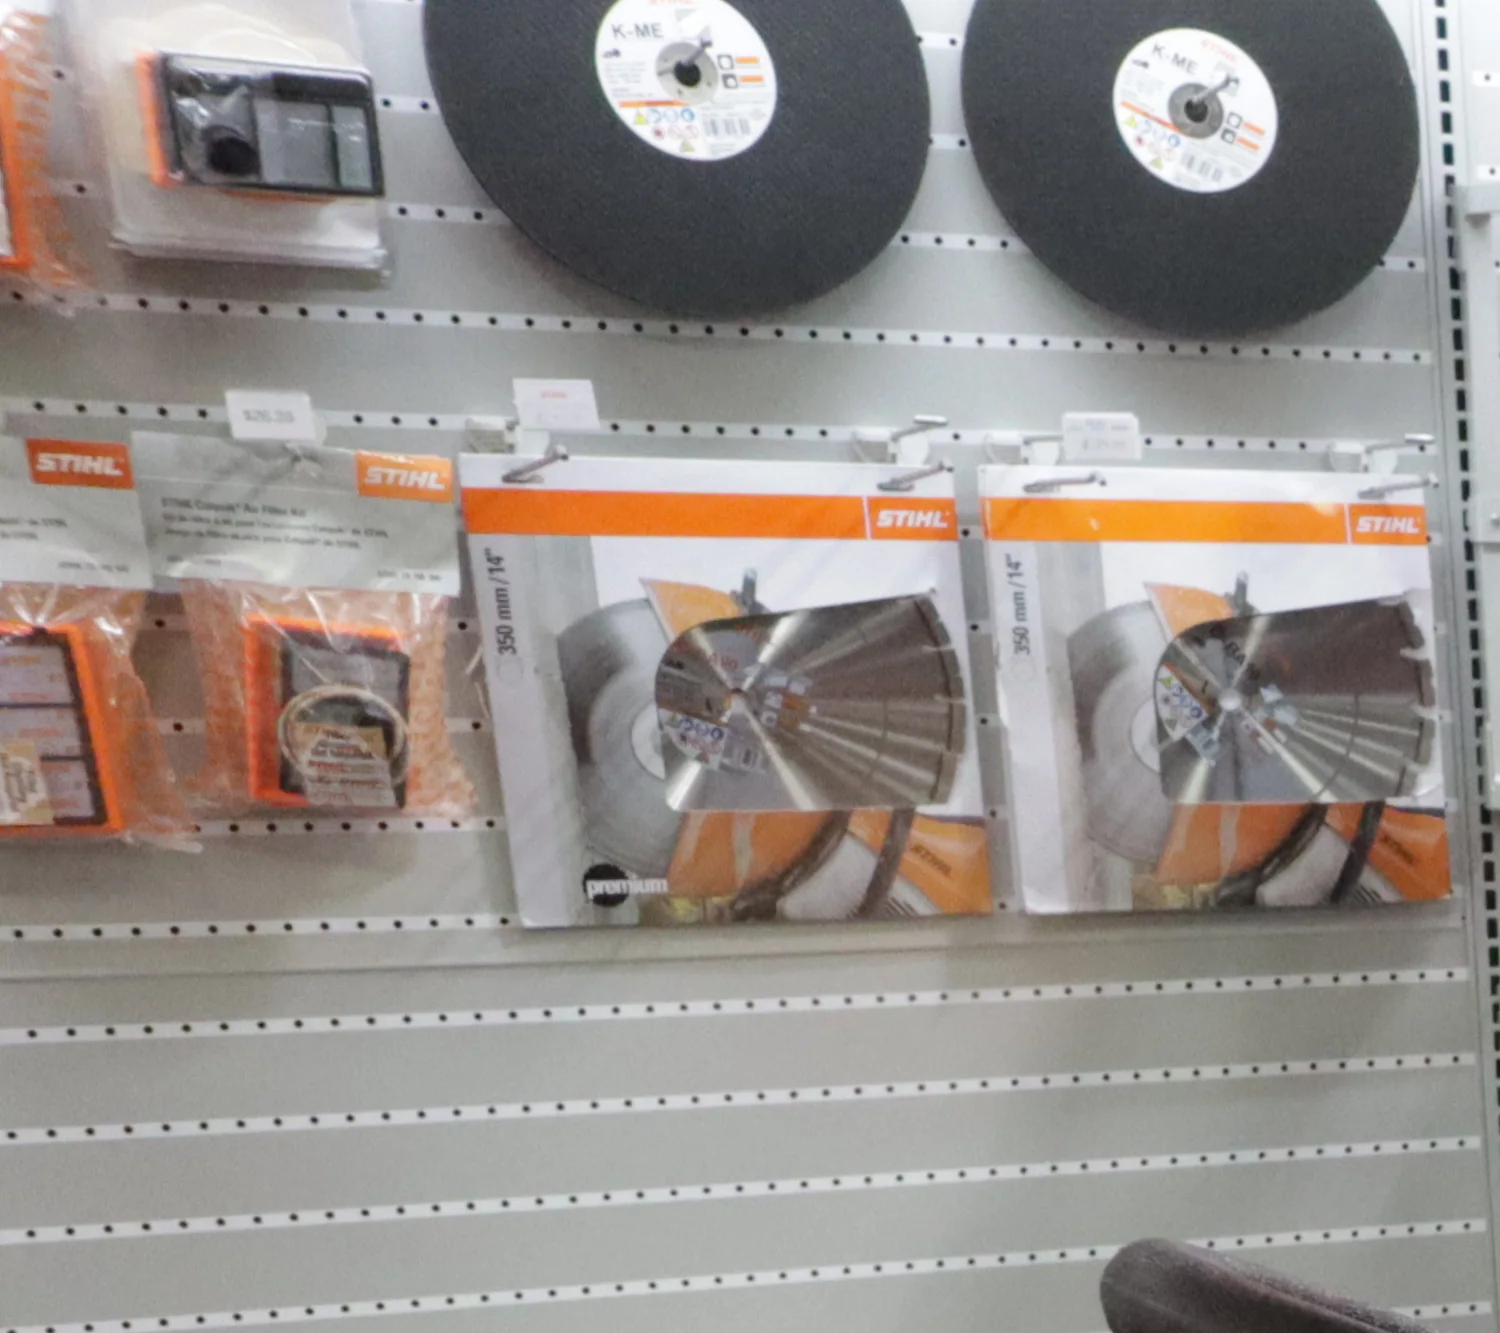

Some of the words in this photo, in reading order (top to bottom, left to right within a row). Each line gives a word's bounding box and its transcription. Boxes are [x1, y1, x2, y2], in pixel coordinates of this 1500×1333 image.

[35, 452, 124, 477] STIHL
[363, 465, 446, 491] STIHL
[876, 509, 949, 529] STIHL
[1356, 516, 1419, 534] STIHL
[496, 588, 512, 619] mm
[1012, 592, 1025, 622] mm
[496, 624, 517, 656] 350
[1013, 626, 1031, 656] 350
[586, 872, 668, 897] premium
